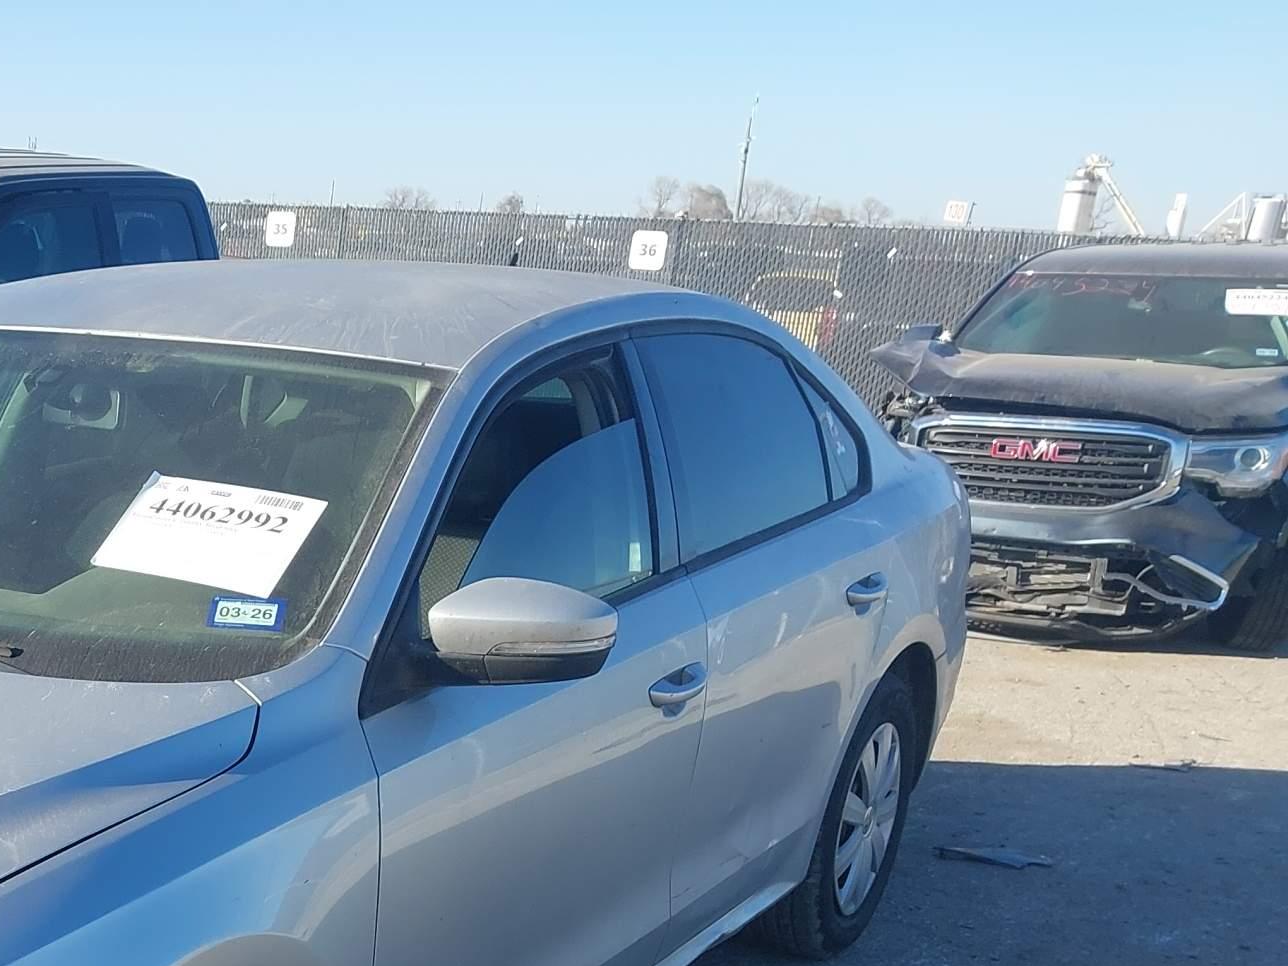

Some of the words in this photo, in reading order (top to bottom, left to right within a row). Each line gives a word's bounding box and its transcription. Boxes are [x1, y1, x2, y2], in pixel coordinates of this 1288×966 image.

[272, 223, 288, 235] 35
[639, 243, 657, 257] 36
[991, 436, 1082, 463] GMC
[149, 497, 289, 534] 44062992
